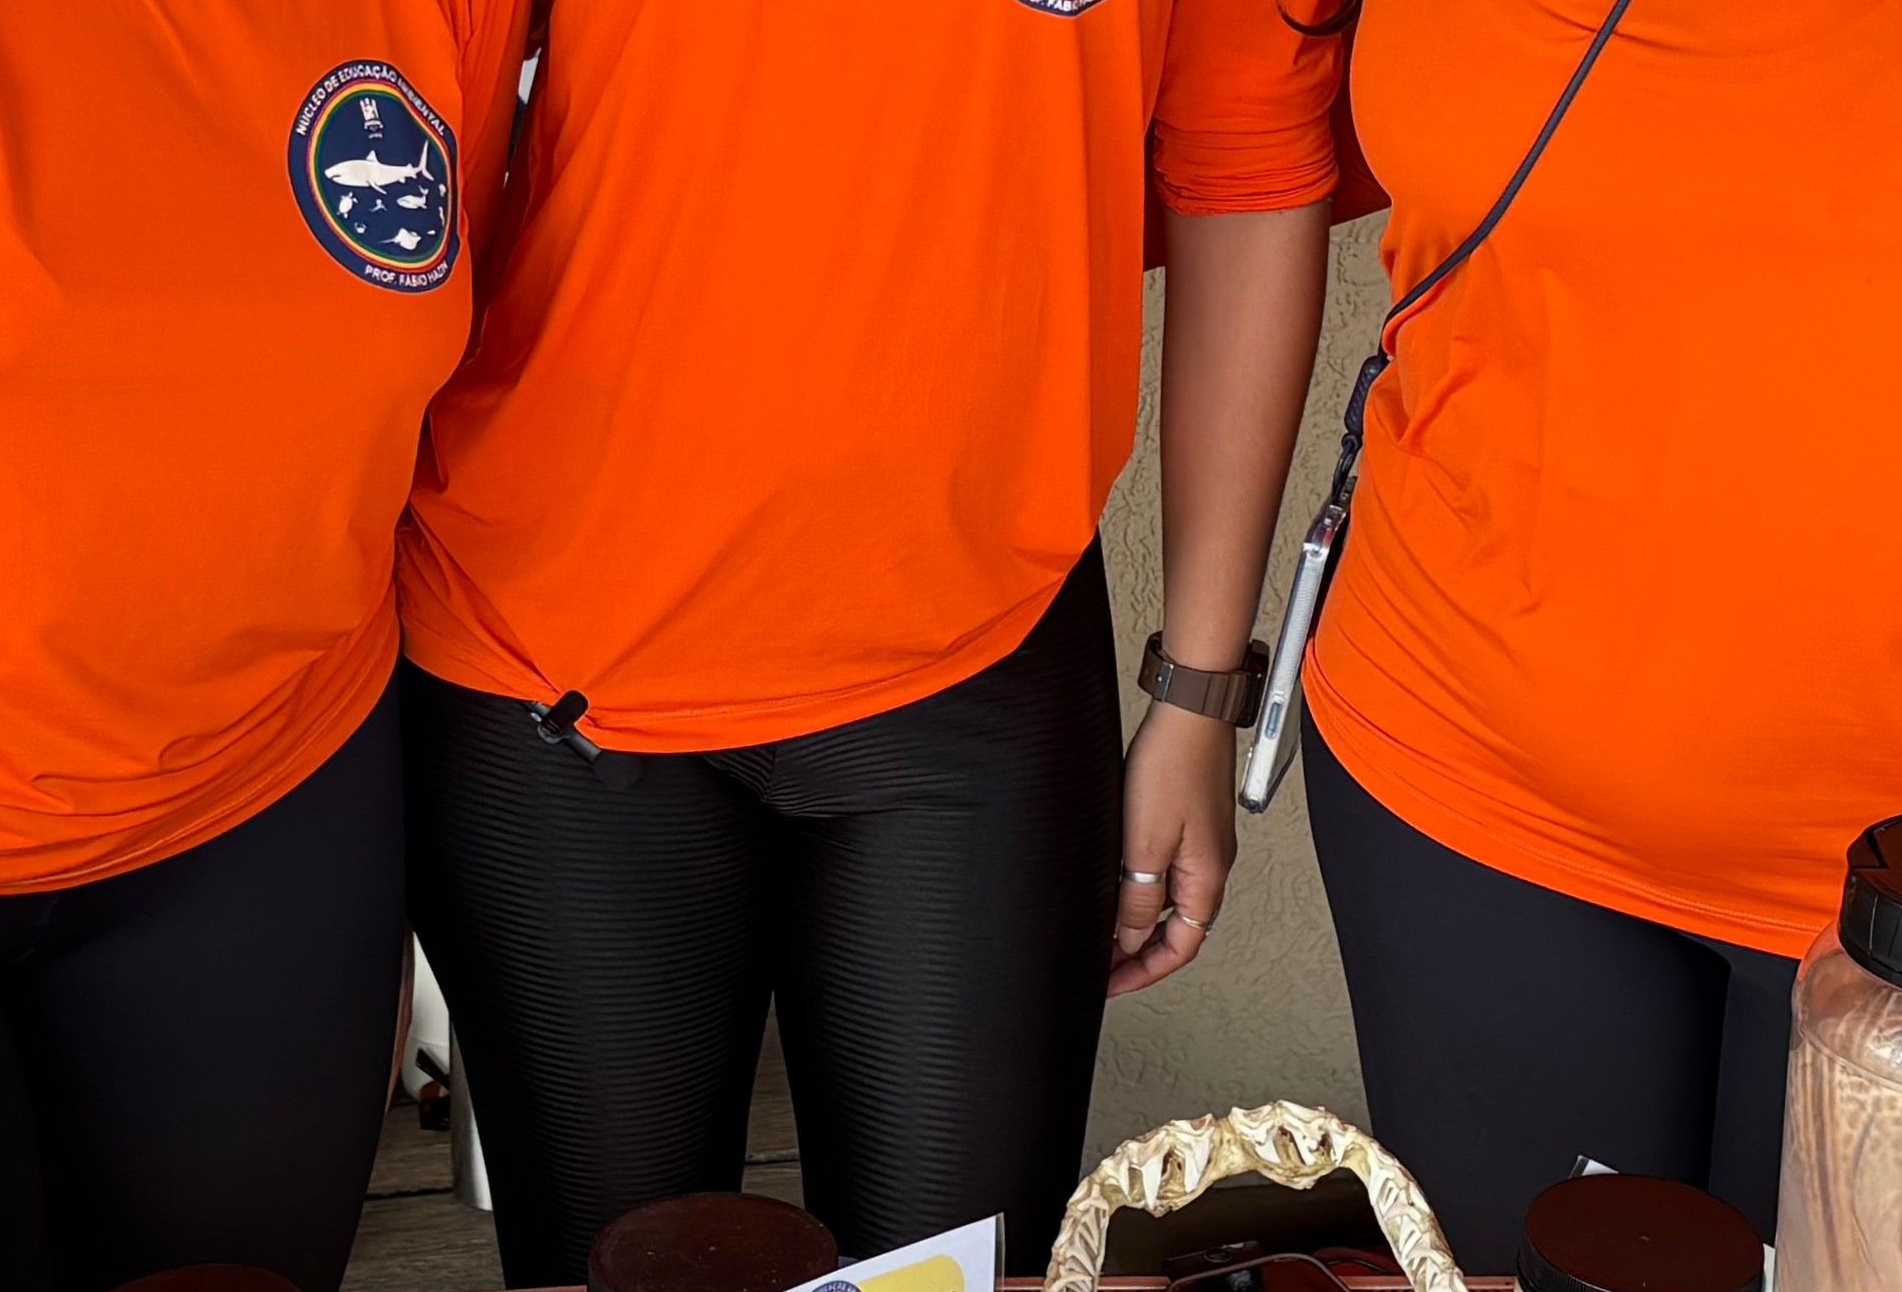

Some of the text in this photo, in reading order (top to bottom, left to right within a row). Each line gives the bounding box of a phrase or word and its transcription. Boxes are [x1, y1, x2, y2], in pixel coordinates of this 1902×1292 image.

[296, 88, 326, 136] NÚCLEO
[324, 76, 339, 94] DE
[364, 263, 397, 285] PROF.
